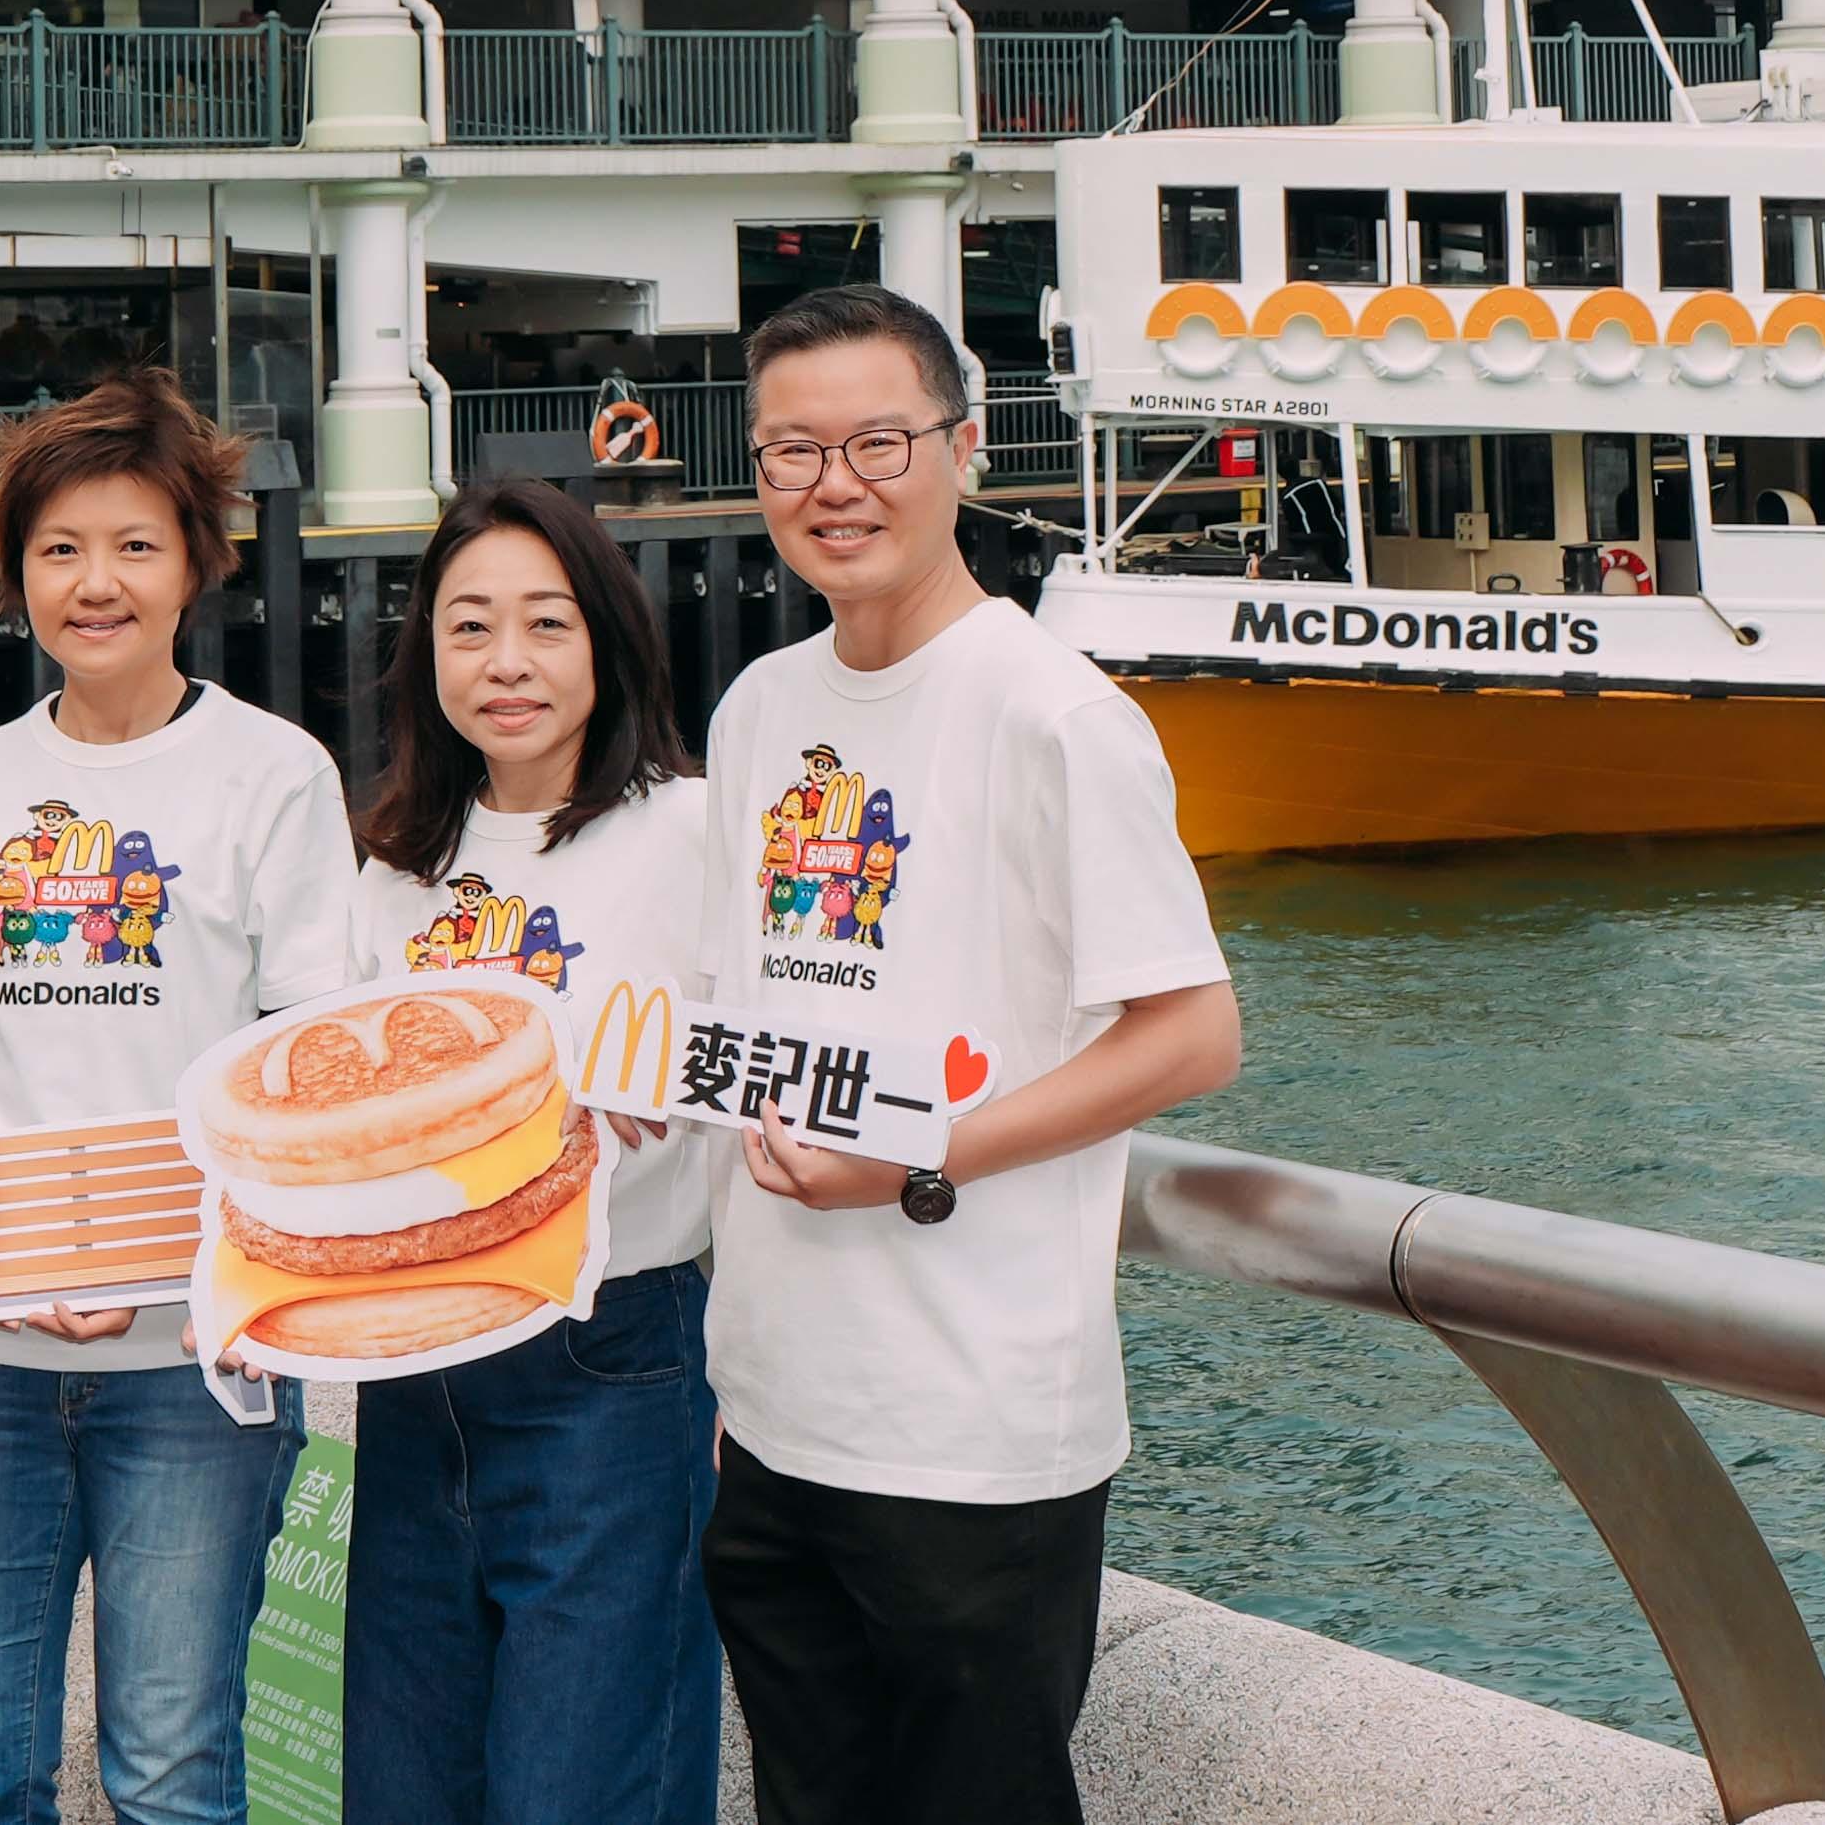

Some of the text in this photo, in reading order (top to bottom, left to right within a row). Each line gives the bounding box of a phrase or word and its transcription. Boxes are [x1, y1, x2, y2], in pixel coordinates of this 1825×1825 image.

[1130, 395, 1329, 416] MORNING STAR A2801
[1230, 601, 1599, 655] McDonald's
[41, 880, 72, 901] 50
[760, 953, 877, 991] McDonald's
